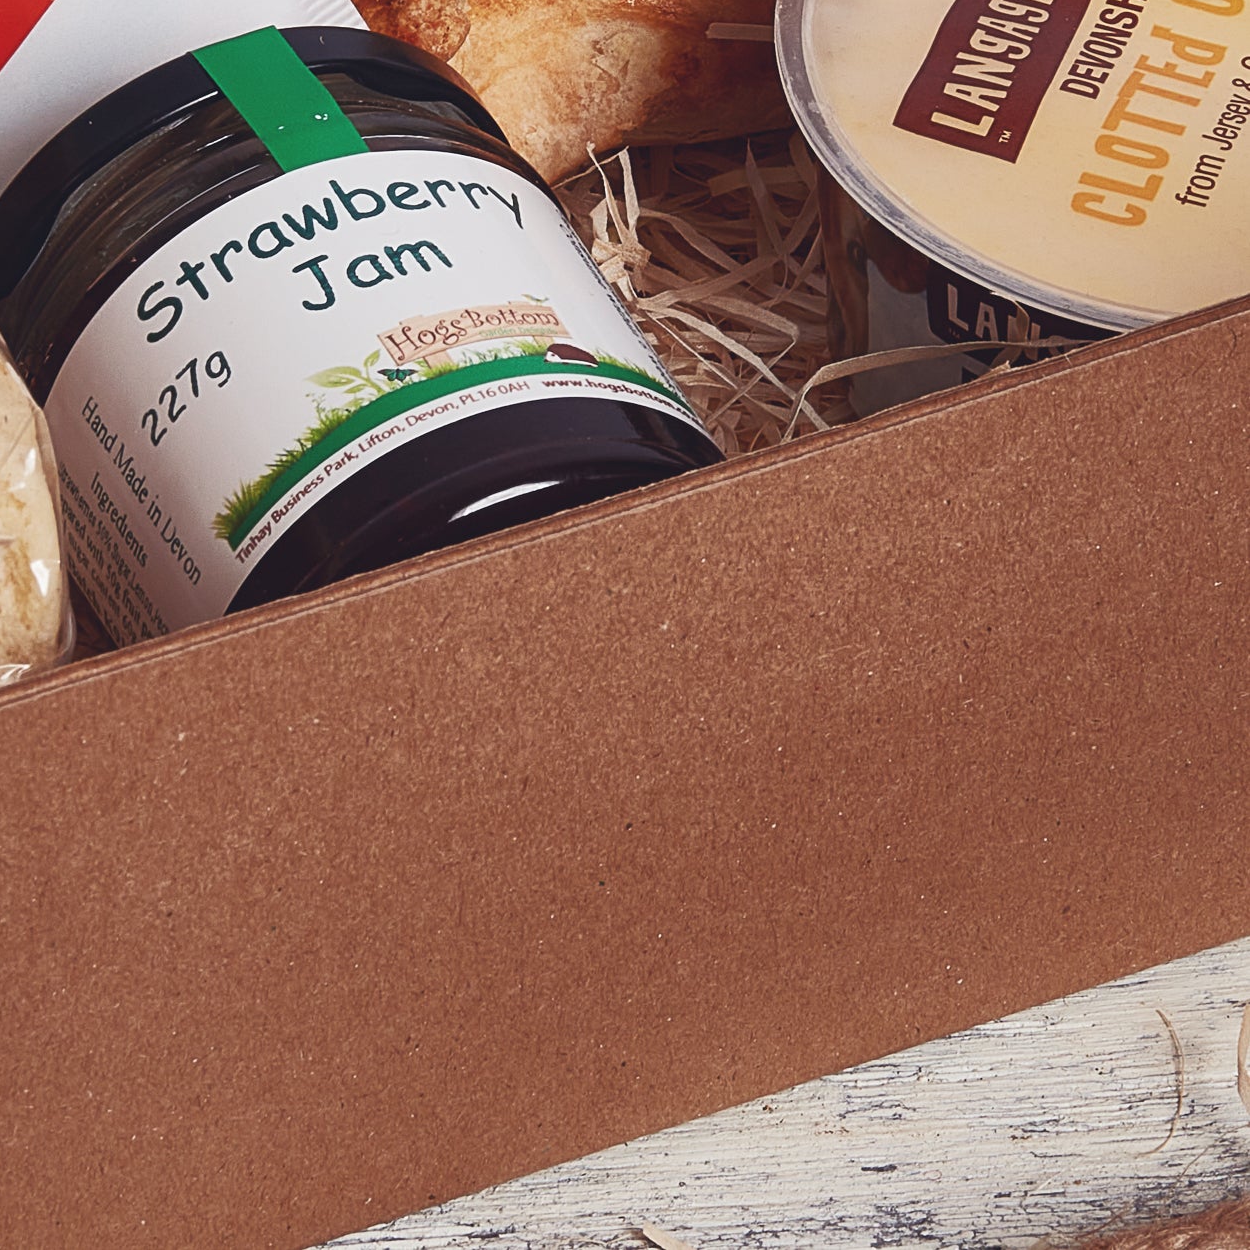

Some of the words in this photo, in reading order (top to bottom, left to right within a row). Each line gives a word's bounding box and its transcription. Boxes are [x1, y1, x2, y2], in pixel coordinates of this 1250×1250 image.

[1175, 153, 1225, 207] from
[136, 179, 524, 343] Strawberry
[292, 240, 453, 311] Jam
[141, 351, 232, 448] 227g
[82, 396, 118, 453] Hand
[113, 443, 149, 504] Made
[147, 495, 162, 527] in
[160, 517, 202, 585] Devon
[91, 471, 148, 568] Ingredients
[235, 520, 273, 564] Tinhay
[271, 475, 324, 525] Business
[323, 450, 359, 477] Park,
[358, 423, 406, 454] Lifton,
[405, 401, 459, 428] Devon,
[459, 387, 497, 406] PL16
